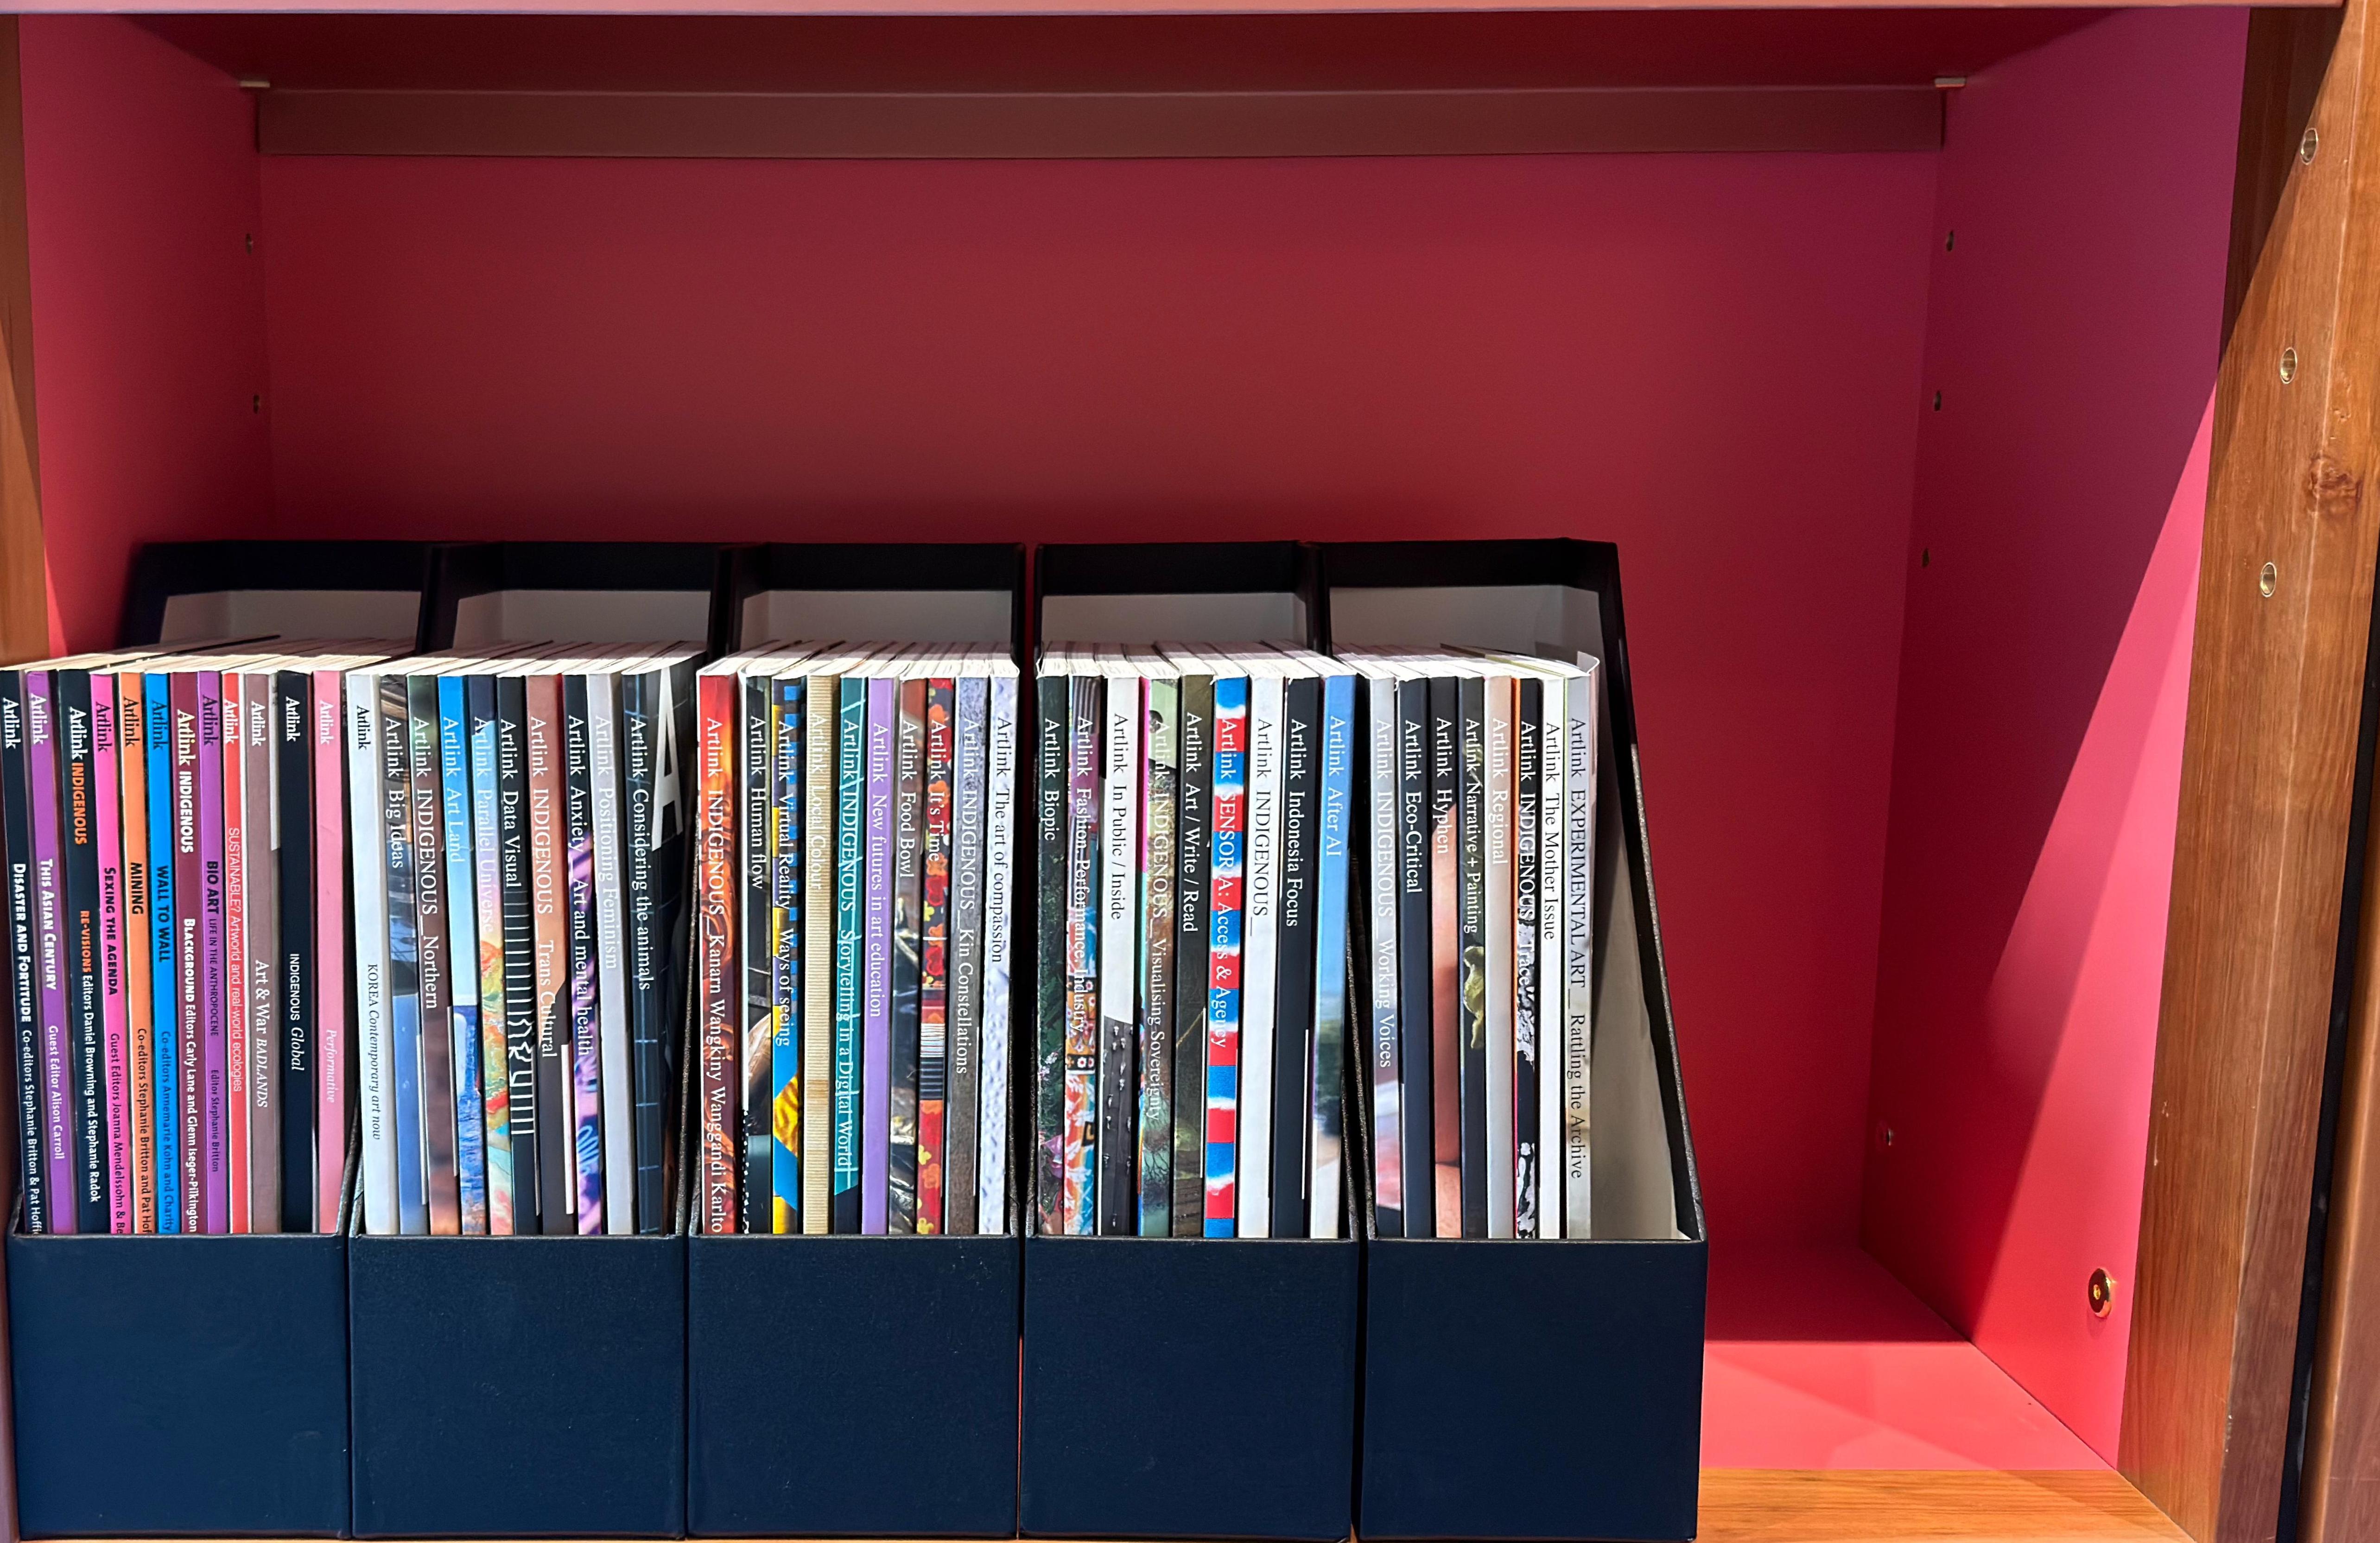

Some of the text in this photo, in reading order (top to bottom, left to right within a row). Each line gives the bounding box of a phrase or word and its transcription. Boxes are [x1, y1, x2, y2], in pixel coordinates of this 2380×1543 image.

[3, 697, 19, 749] Artlink
[31, 693, 47, 744] Artlink
[778, 721, 793, 782] Artlink
[1043, 718, 1060, 841] Artlink Biopic
[1076, 717, 1093, 777] Artlink
[1220, 720, 1236, 779] Artlink
[1432, 718, 1452, 854] Artlink Hyphen
[151, 700, 171, 963] Artlink WALL TO WALL
[386, 717, 406, 868] Artlink Big Ideas
[501, 719, 522, 888] Artlink Data Visual
[631, 717, 654, 990] Artlink Considering the animals
[750, 716, 767, 889] Artlink Human flow
[779, 793, 794, 847] Virtual
[900, 720, 918, 878] Artlink Food Bowl
[928, 720, 946, 861] Artlink It's Time
[990, 717, 1012, 963] Artlink The art of compassion
[1286, 719, 1307, 927] Artlink Indonesia Focus
[1405, 720, 1422, 893] Artlink Eco-Critical
[1543, 722, 1560, 940] Artlink The Mother Issue
[202, 695, 221, 1172] Artlink BIO ART LIFE IN THE ANTHROPOCENE Editor Stephanie Britton
[224, 699, 243, 1091] Artlink SUSTAINABLE? Artworld and real-world ecologies
[252, 701, 270, 1107] Artlink Art & War BADLANDS
[286, 696, 305, 1070] Artlink INDIGENOUS Global
[319, 700, 338, 1103] Artlink Performative
[356, 705, 381, 1140] Artlink KOREA Contemporary art now
[568, 715, 593, 1056] Artlink Anxiety Art and mental health
[775, 854, 794, 910] Reality
[870, 723, 889, 1017] Artlink New futures in art education
[1216, 904, 1232, 960] Access
[70, 706, 100, 1202] Artlink INDIGENOUS RE-VISIONS Editors Daniel Browning and Stephanie Radok
[95, 702, 126, 1219] Artlink SEXING THE AGENDA Guest Editors Joanna Mendelssohn &
[123, 697, 151, 1213] Artlink MINING Co-editors Stephanie Britton and Pat
[177, 709, 199, 1232] Artlink INDIGENOUS BLACKGROUND Editors Carly Lane and Glenn Iseger-Pilkington
[779, 975, 793, 993] of
[1211, 986, 1230, 1047] Agency
[1216, 966, 1231, 980] &
[1567, 718, 1586, 1179] Artlink EXPERIMENTAL ART Rattling the Archive
[23, 1030, 33, 1082] Co-editors
[48, 1025, 58, 1056] Guest
[51, 1058, 61, 1089] Editor
[775, 997, 790, 1047] seeing
[25, 1085, 37, 1136] Stephanie
[28, 1138, 38, 1174] Britton
[52, 1091, 63, 1123] Alison
[53, 1125, 64, 1159] Carroll
[31, 1177, 39, 1185] &
[31, 1188, 40, 1204] Pat
